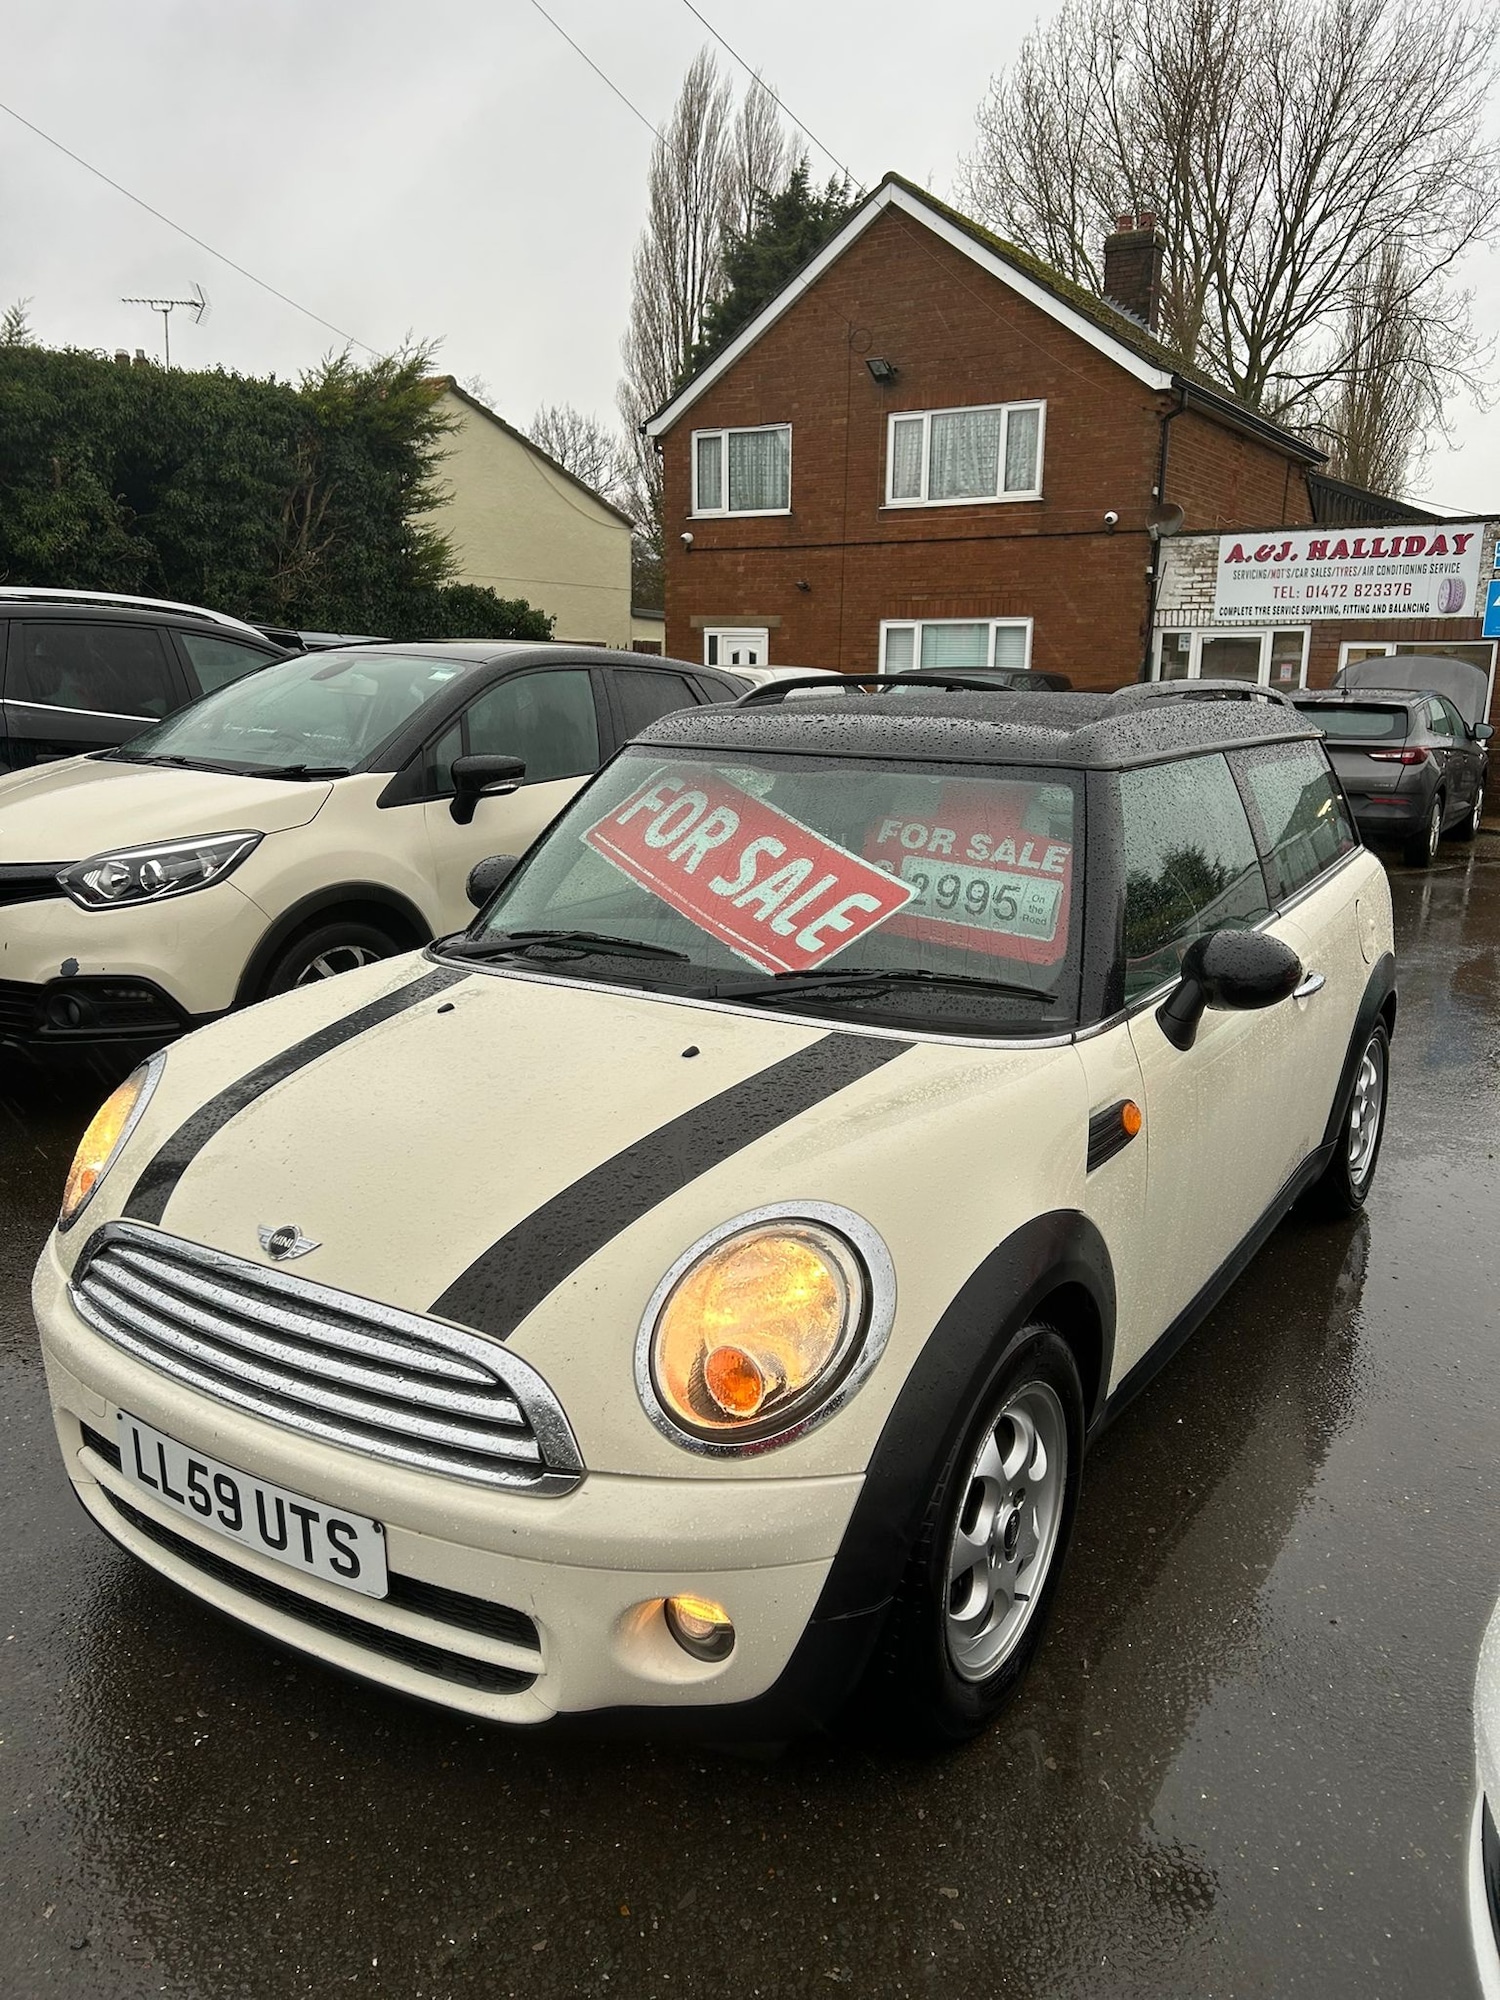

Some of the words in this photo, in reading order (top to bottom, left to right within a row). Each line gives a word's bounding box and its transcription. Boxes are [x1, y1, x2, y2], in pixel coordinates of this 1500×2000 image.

[1306, 533, 1474, 560] HALLIDAY
[1376, 563, 1427, 576] CONDITIONING
[1429, 562, 1461, 574] SERVICE
[1273, 586, 1300, 599] TEL:
[1306, 584, 1348, 598] 01472
[1354, 583, 1412, 597] 823376
[1219, 606, 1253, 616] COMPLETE
[1255, 605, 1271, 616] TYRE
[1272, 605, 1300, 616] SERVICE
[1301, 604, 1341, 617] SUPPLYING,
[1342, 604, 1370, 614] FITTING
[1372, 603, 1387, 613] AND
[1388, 602, 1430, 613] BALANCING
[877, 819, 957, 854] FOR
[965, 833, 1073, 874] SALE
[616, 777, 741, 875] FOR
[708, 836, 882, 953] SALE
[909, 872, 1021, 922] 2995
[1031, 894, 1046, 904] On
[1028, 904, 1044, 915] the
[1022, 913, 1047, 926] Road
[272, 1234, 295, 1248] MINI
[132, 1427, 243, 1531] LL59
[255, 1489, 361, 1579] UTS
